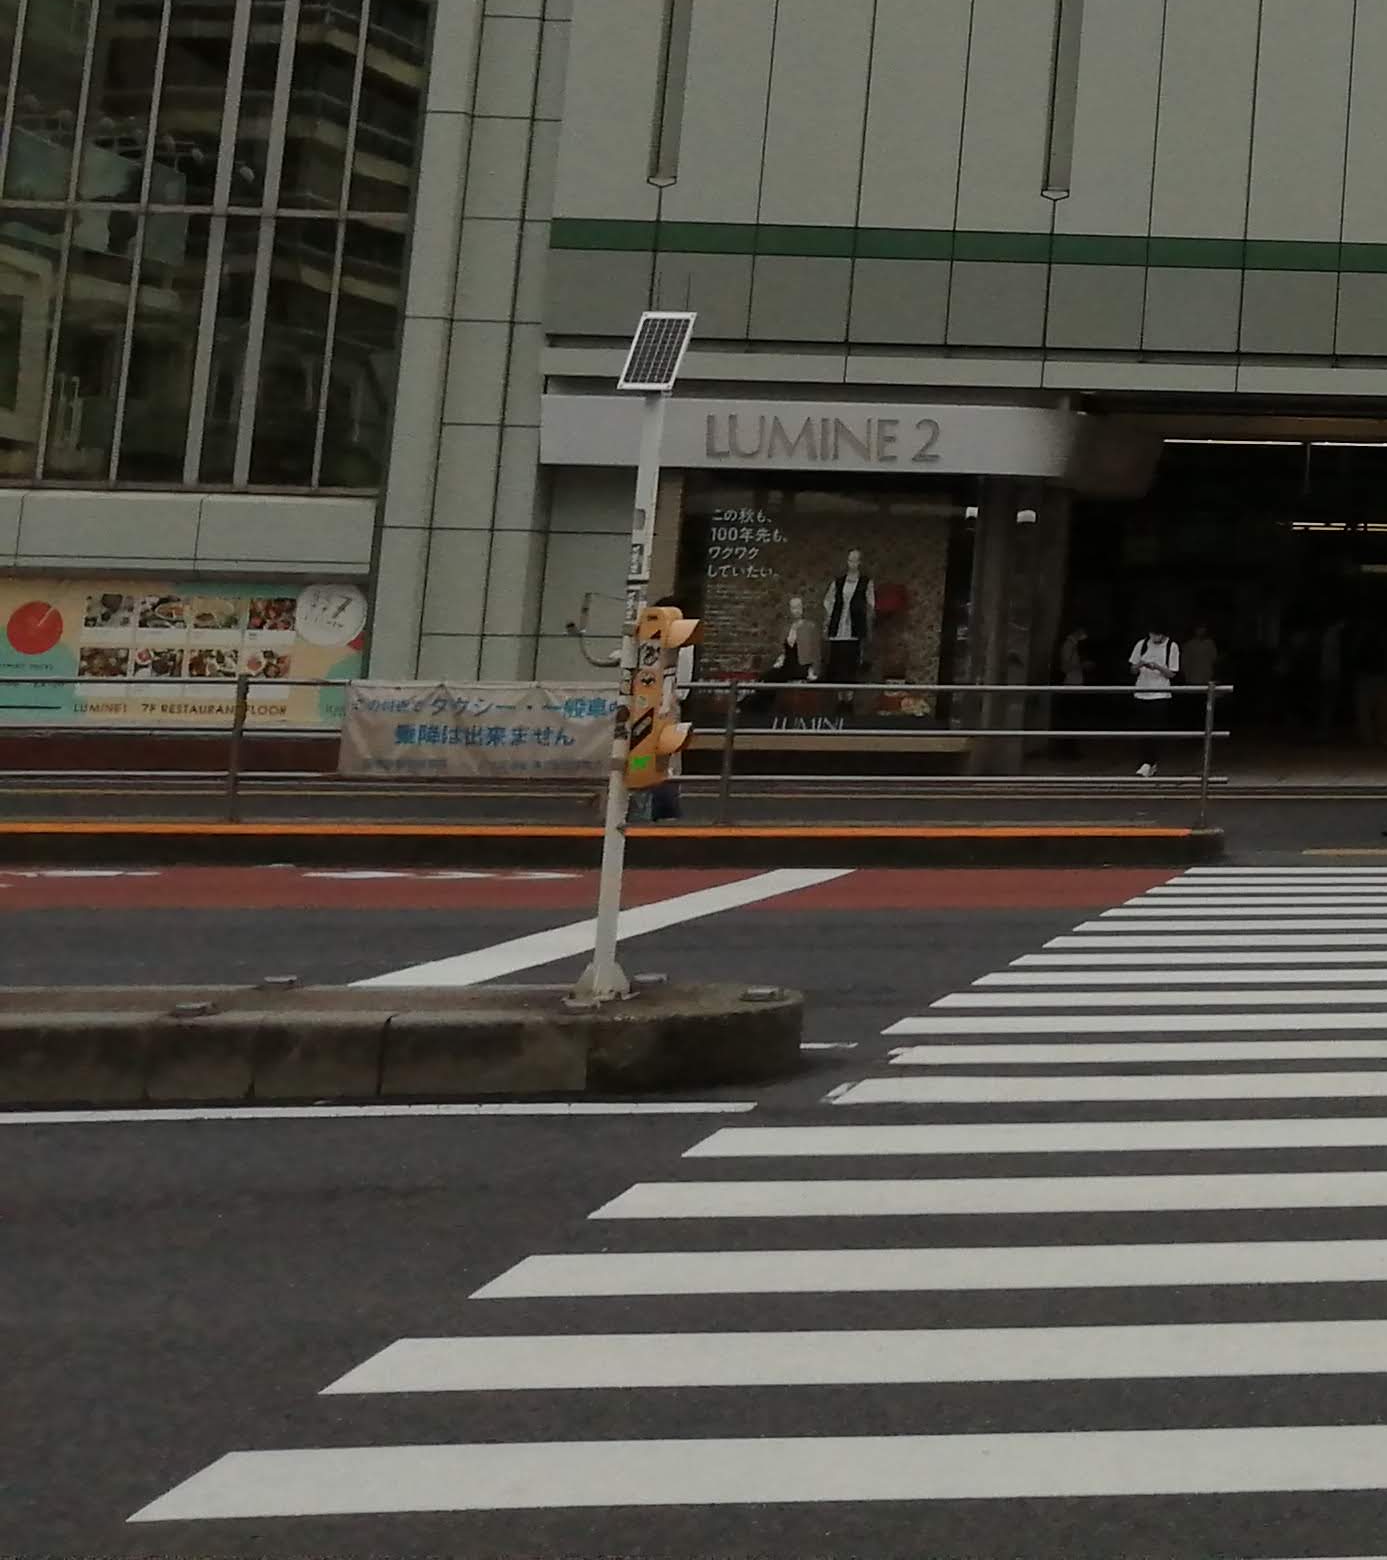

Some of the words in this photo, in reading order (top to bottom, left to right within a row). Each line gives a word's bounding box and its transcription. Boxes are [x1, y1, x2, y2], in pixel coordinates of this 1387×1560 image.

[705, 414, 900, 463] LUMINE
[911, 418, 942, 463] 2
[160, 704, 241, 716] RESTAURAN
